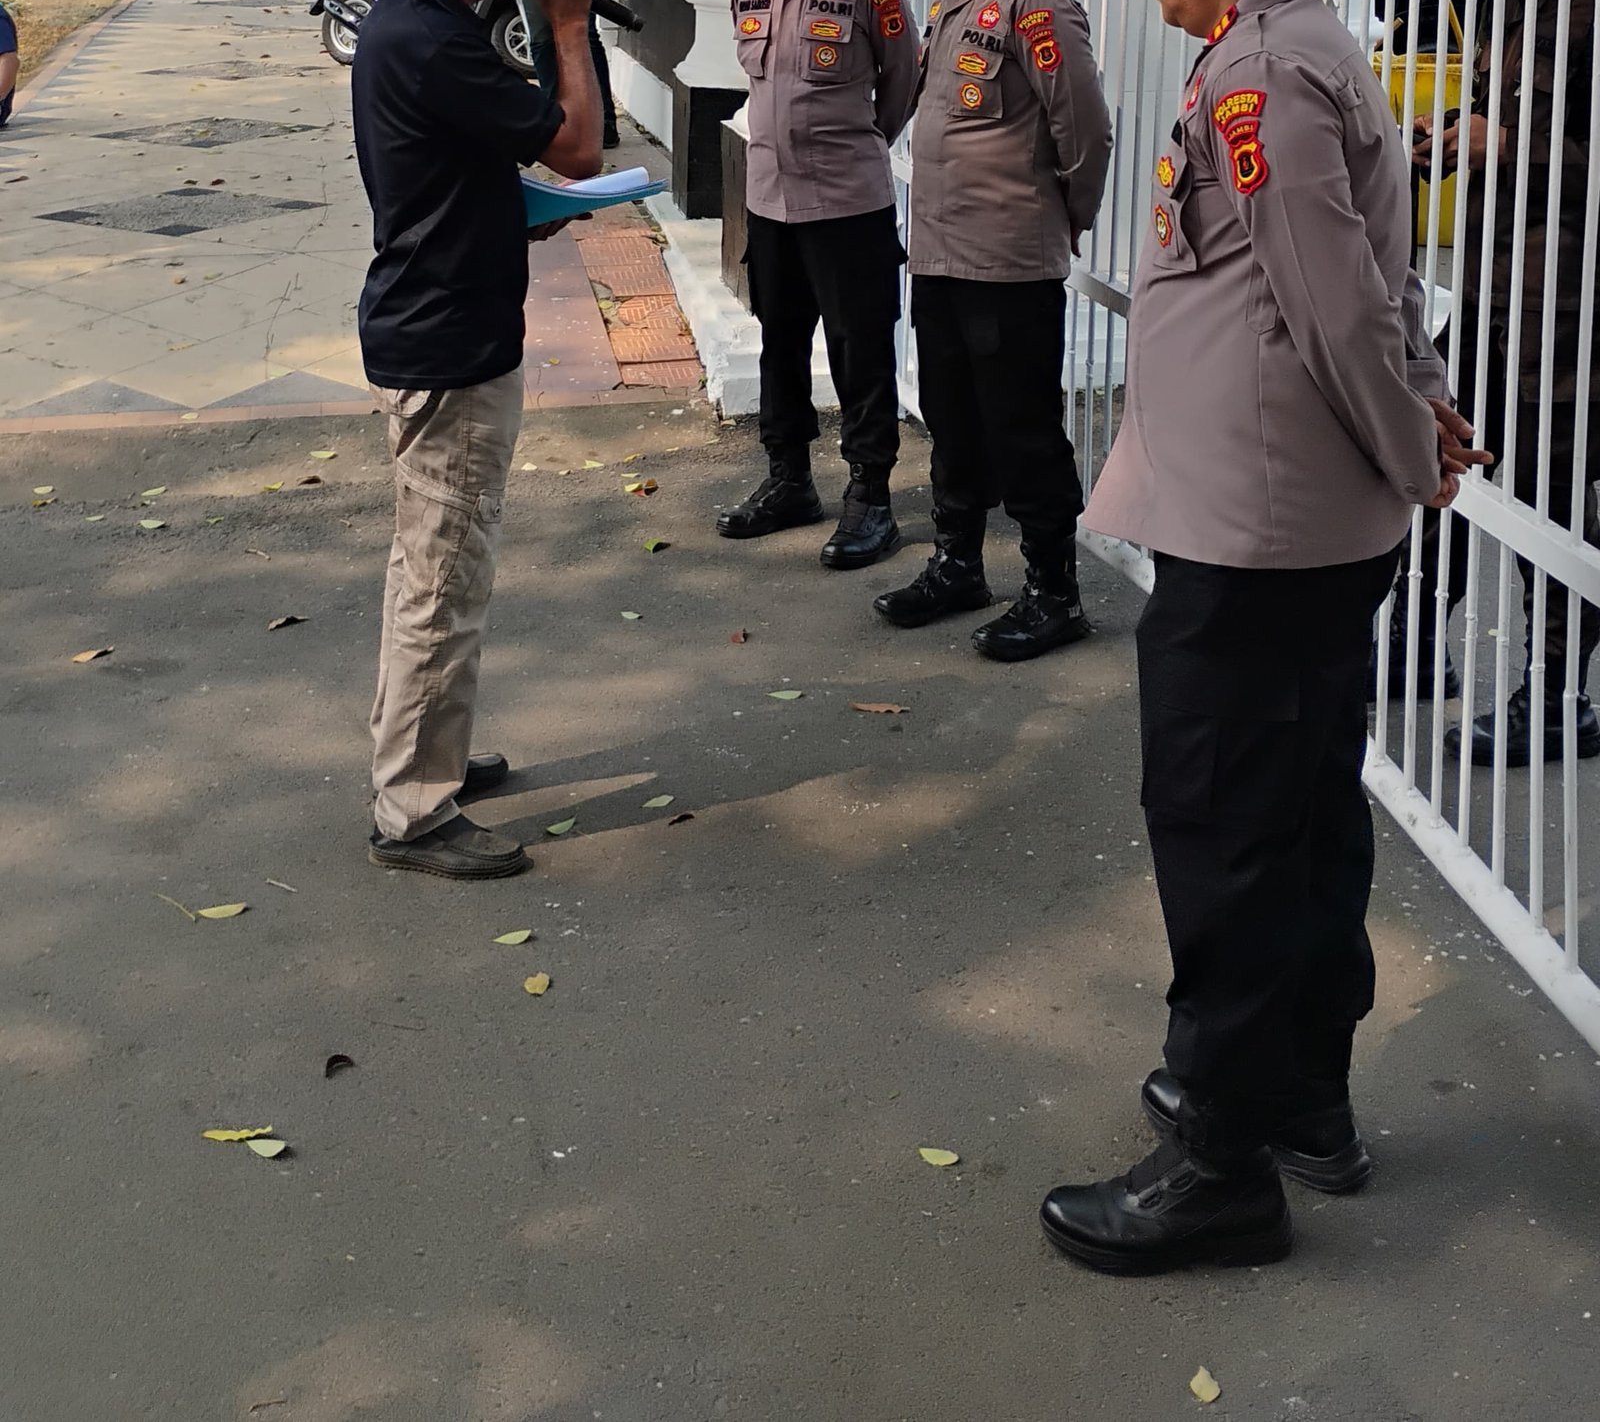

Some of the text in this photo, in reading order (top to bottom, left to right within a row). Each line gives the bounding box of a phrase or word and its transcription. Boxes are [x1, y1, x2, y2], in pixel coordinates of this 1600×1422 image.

[809, 0, 853, 16] POLRI
[1019, 11, 1049, 29] POLRESTA
[961, 29, 1001, 51] POLRI
[1215, 93, 1258, 121] POLRESTA
[1220, 103, 1254, 125] JAMBI
